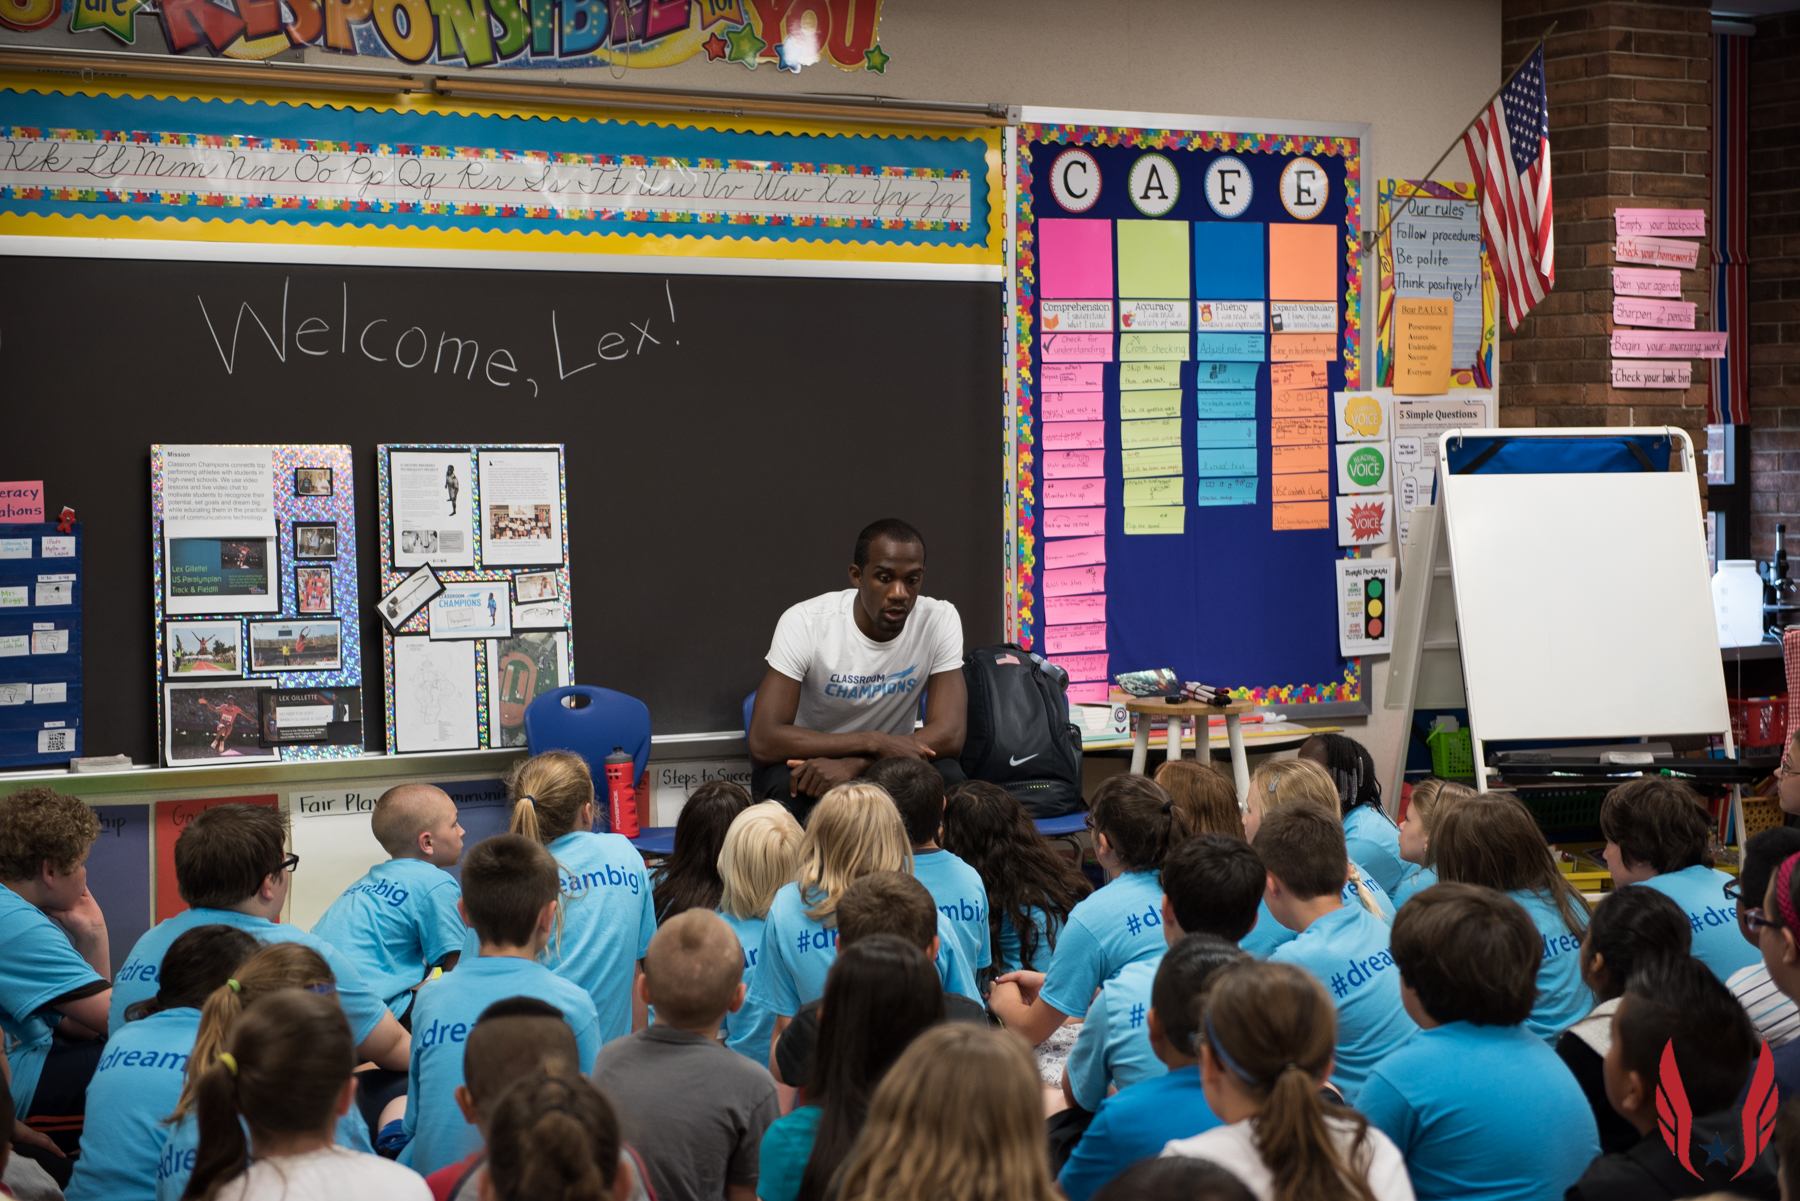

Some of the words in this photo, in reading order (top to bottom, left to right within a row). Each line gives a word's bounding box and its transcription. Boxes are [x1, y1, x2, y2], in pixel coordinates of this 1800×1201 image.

[1407, 200, 1430, 216] Our
[1436, 202, 1464, 216] rules
[1620, 215, 1642, 231] Empty
[1649, 221, 1664, 230] your
[1667, 217, 1699, 231] backpack
[1397, 223, 1426, 240] Follow
[1432, 229, 1480, 245] procedures
[1396, 248, 1412, 265] Be
[1417, 251, 1449, 268] polite
[1618, 244, 1638, 256] Check
[1641, 250, 1655, 259] your
[1396, 273, 1424, 289] Think
[1428, 275, 1479, 296] positively!
[1615, 276, 1631, 291] Open
[1636, 280, 1651, 290] your
[1654, 281, 1679, 294] agenda
[1043, 303, 1110, 312] Comprehension
[1136, 303, 1174, 312] Accuracy
[1216, 303, 1248, 312] Fluency
[1617, 304, 1651, 321] Sharpen
[1667, 311, 1691, 322] pencils
[198, 275, 538, 398] Welcome,
[552, 279, 680, 380] Lex!
[1615, 337, 1640, 352] Begin
[1647, 343, 1664, 354] your
[1669, 343, 1701, 354] morning
[1704, 341, 1721, 351] work
[1615, 369, 1640, 383] Check
[1644, 373, 1660, 386] your
[1663, 371, 1675, 383] book
[1678, 370, 1690, 382] bin
[1406, 410, 1434, 420] Simple
[1435, 410, 1477, 420] Questions
[1349, 464, 1380, 477] VOICE
[1354, 518, 1379, 529] VOICE
[172, 565, 183, 573] Lex
[439, 599, 481, 608] CHAMPIONS
[830, 674, 885, 684] CLASSROOM
[824, 678, 917, 699] CHAMPIONS
[663, 768, 697, 790] Steps
[703, 769, 713, 782] to
[300, 796, 335, 813] Fair
